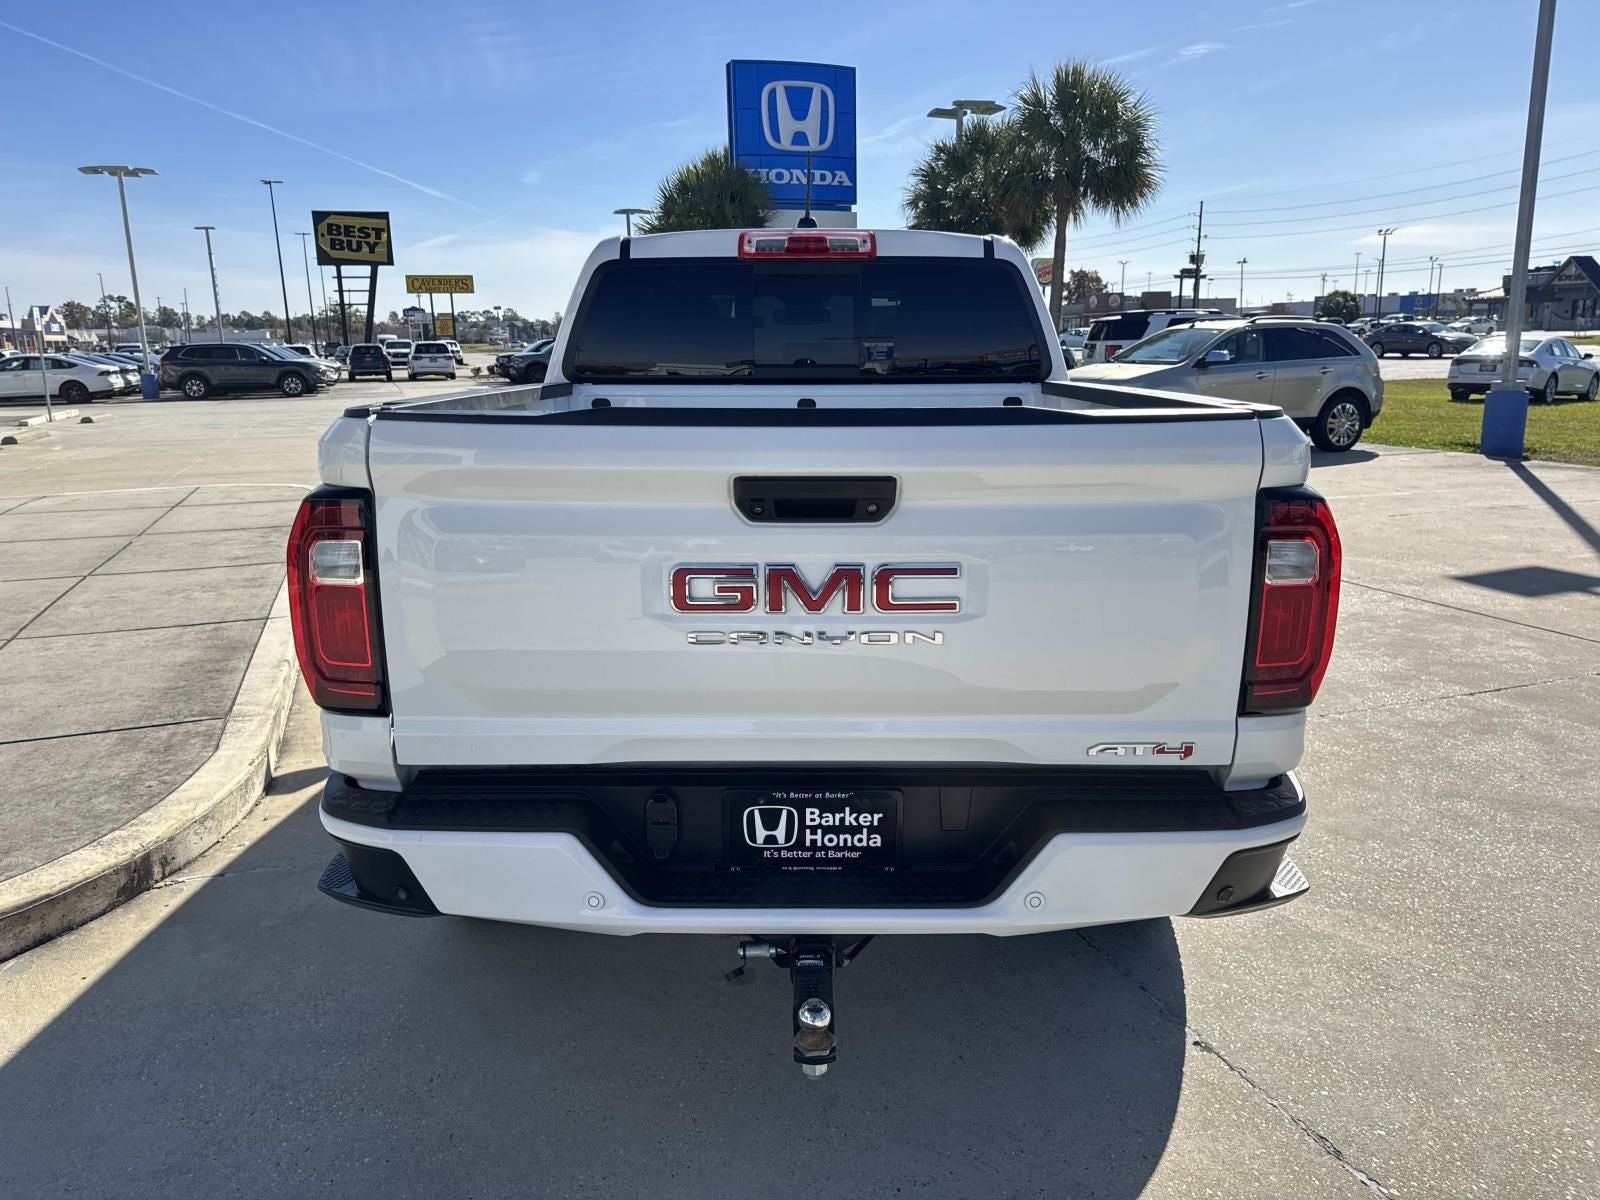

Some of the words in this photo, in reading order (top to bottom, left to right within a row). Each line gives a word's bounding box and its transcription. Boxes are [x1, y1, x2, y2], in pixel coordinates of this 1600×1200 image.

[326, 223, 386, 240] BEST
[330, 237, 380, 254] BUY
[670, 562, 960, 614] GMC
[687, 630, 944, 645] CANYON
[1087, 742, 1195, 760] AT4
[805, 807, 883, 826] Barker
[805, 828, 882, 847] Honda
[763, 849, 779, 858] It's
[781, 850, 813, 858] Better
[815, 850, 826, 858] at
[828, 850, 861, 858] Barker
